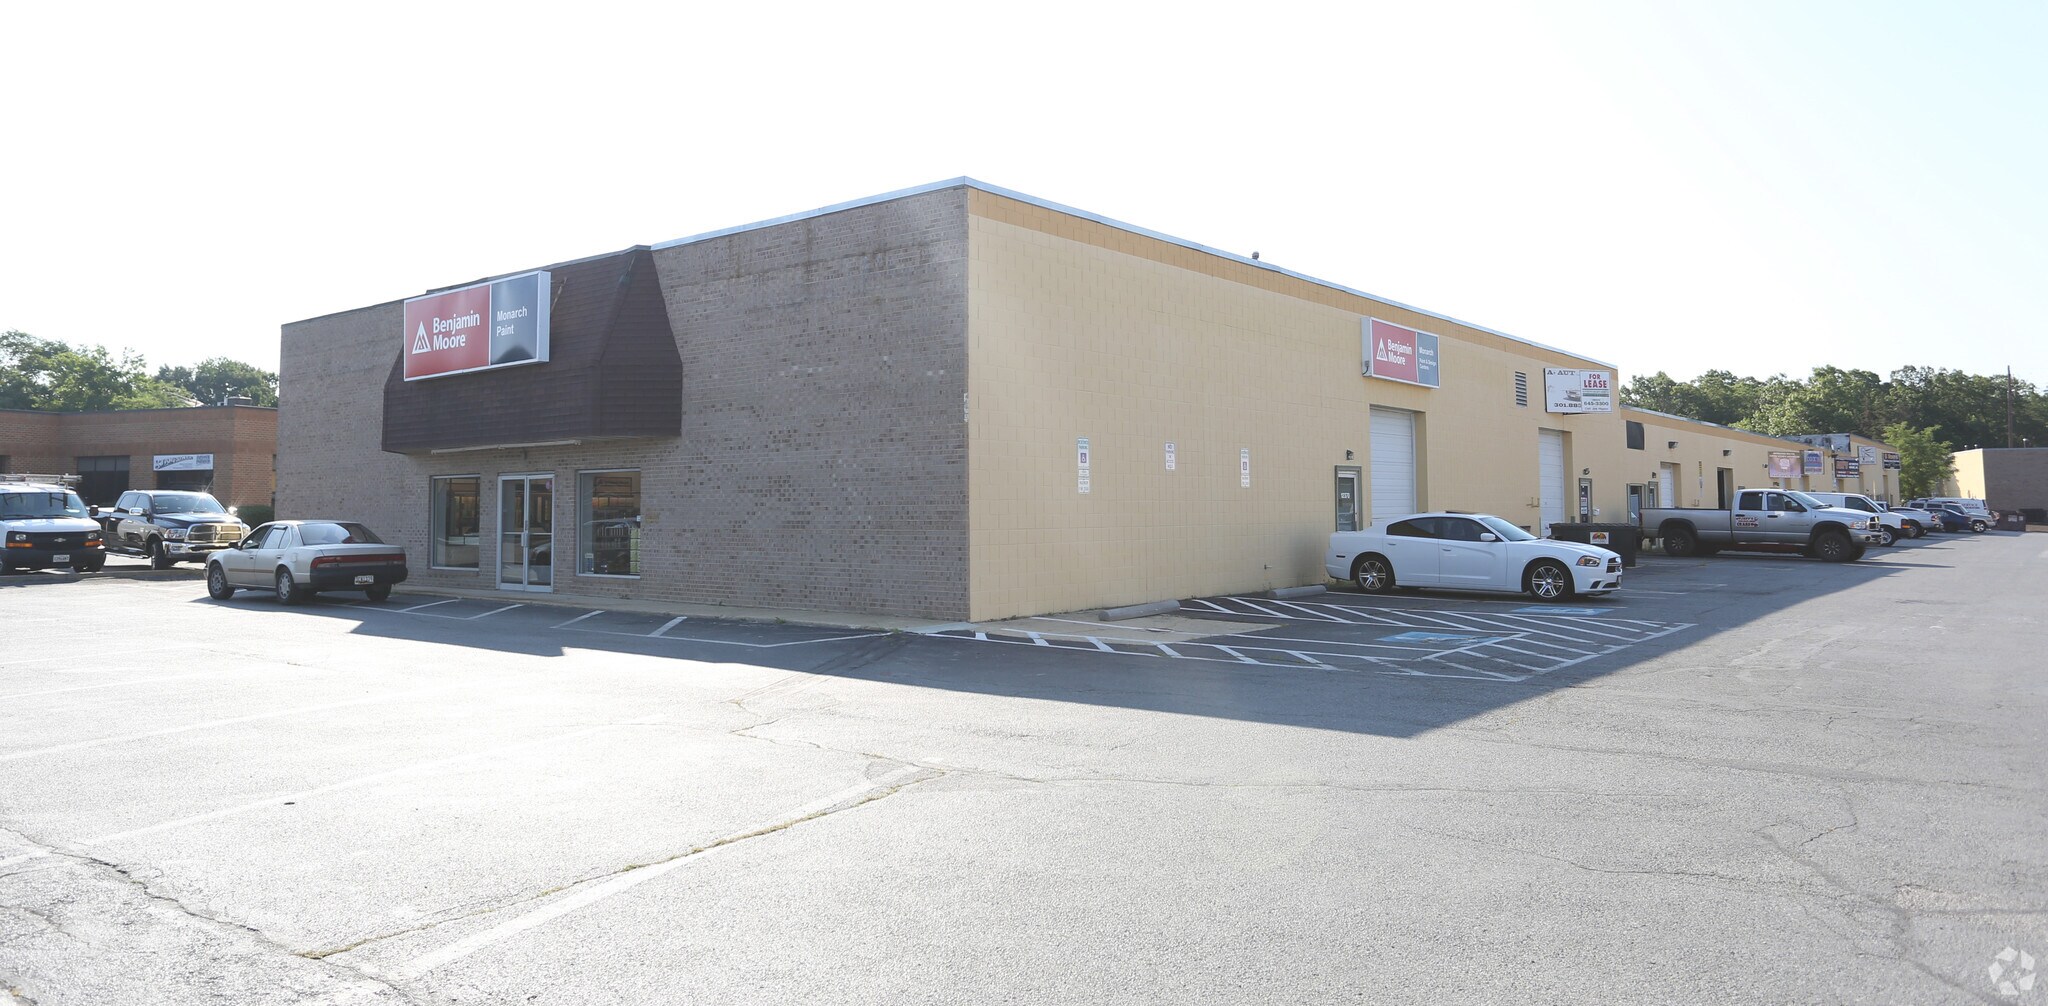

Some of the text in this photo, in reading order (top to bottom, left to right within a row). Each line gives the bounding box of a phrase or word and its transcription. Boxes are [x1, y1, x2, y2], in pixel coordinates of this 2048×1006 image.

[496, 306, 528, 322] Monarch
[433, 310, 480, 335] Benjamin
[496, 325, 514, 337] Paint
[433, 334, 466, 351] Moore
[1387, 339, 1413, 355] Benjamin
[1388, 351, 1406, 366] Moore
[1584, 380, 1607, 388] LEASE
